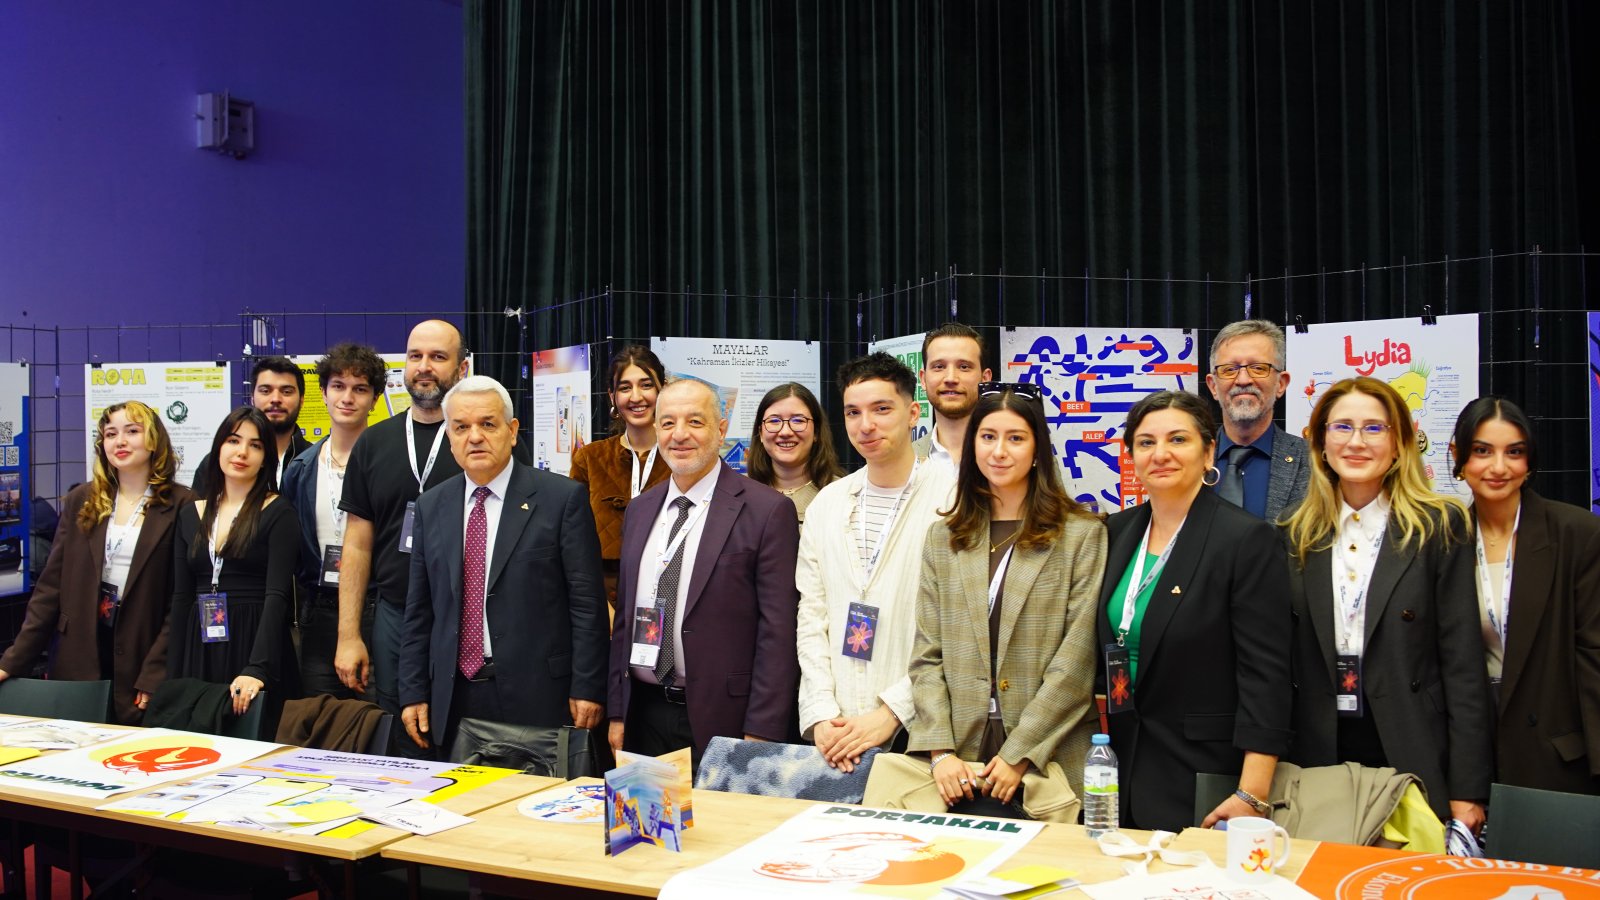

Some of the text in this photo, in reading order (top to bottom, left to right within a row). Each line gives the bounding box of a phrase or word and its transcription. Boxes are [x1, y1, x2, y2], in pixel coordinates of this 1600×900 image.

[712, 344, 769, 355] MAYALAR
[1344, 335, 1412, 377] Lydia
[91, 368, 146, 385] ROTA
[823, 806, 1022, 833] PORTAKAL
[1435, 857, 1548, 872] TOBB
